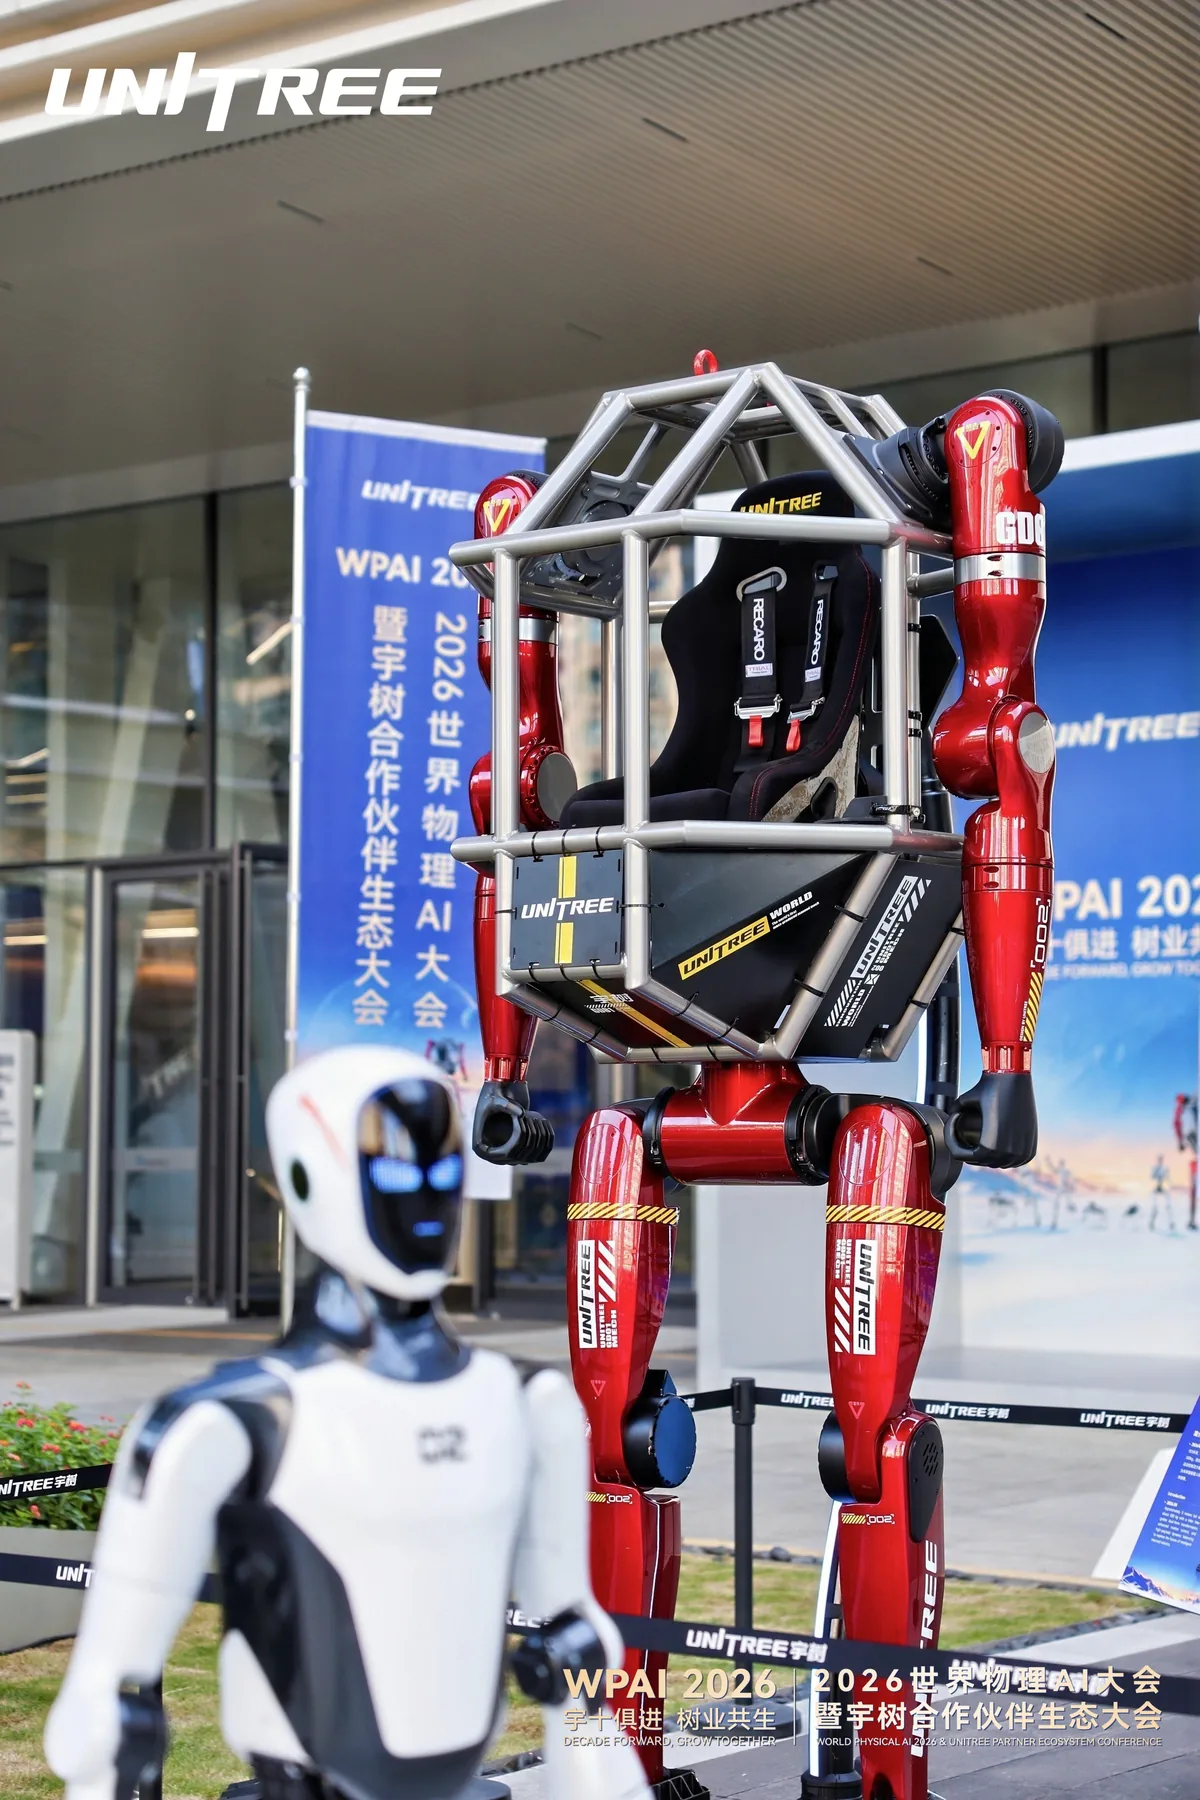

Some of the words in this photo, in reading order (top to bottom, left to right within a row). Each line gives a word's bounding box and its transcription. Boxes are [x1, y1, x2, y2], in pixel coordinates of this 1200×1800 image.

[335, 547, 421, 584] WPAI
[430, 557, 476, 590] 20
[753, 598, 765, 661] RECARO
[811, 598, 824, 665] RECARO
[353, 605, 408, 1027] 暨宇树合作伙伴生态大会
[520, 897, 614, 920] UNITREE
[769, 891, 813, 919] WORLD
[1053, 877, 1123, 921] PAI
[683, 921, 766, 975] UNITREE
[856, 879, 912, 975] UNITREE
[841, 989, 866, 1027] WORLD
[844, 1239, 852, 1286] UNITREE
[579, 1243, 594, 1345] UNITREE
[855, 1243, 875, 1351] UNITREE
[607, 1494, 632, 1504] 002
[867, 1515, 894, 1524] 002
[919, 1540, 938, 1649] REE
